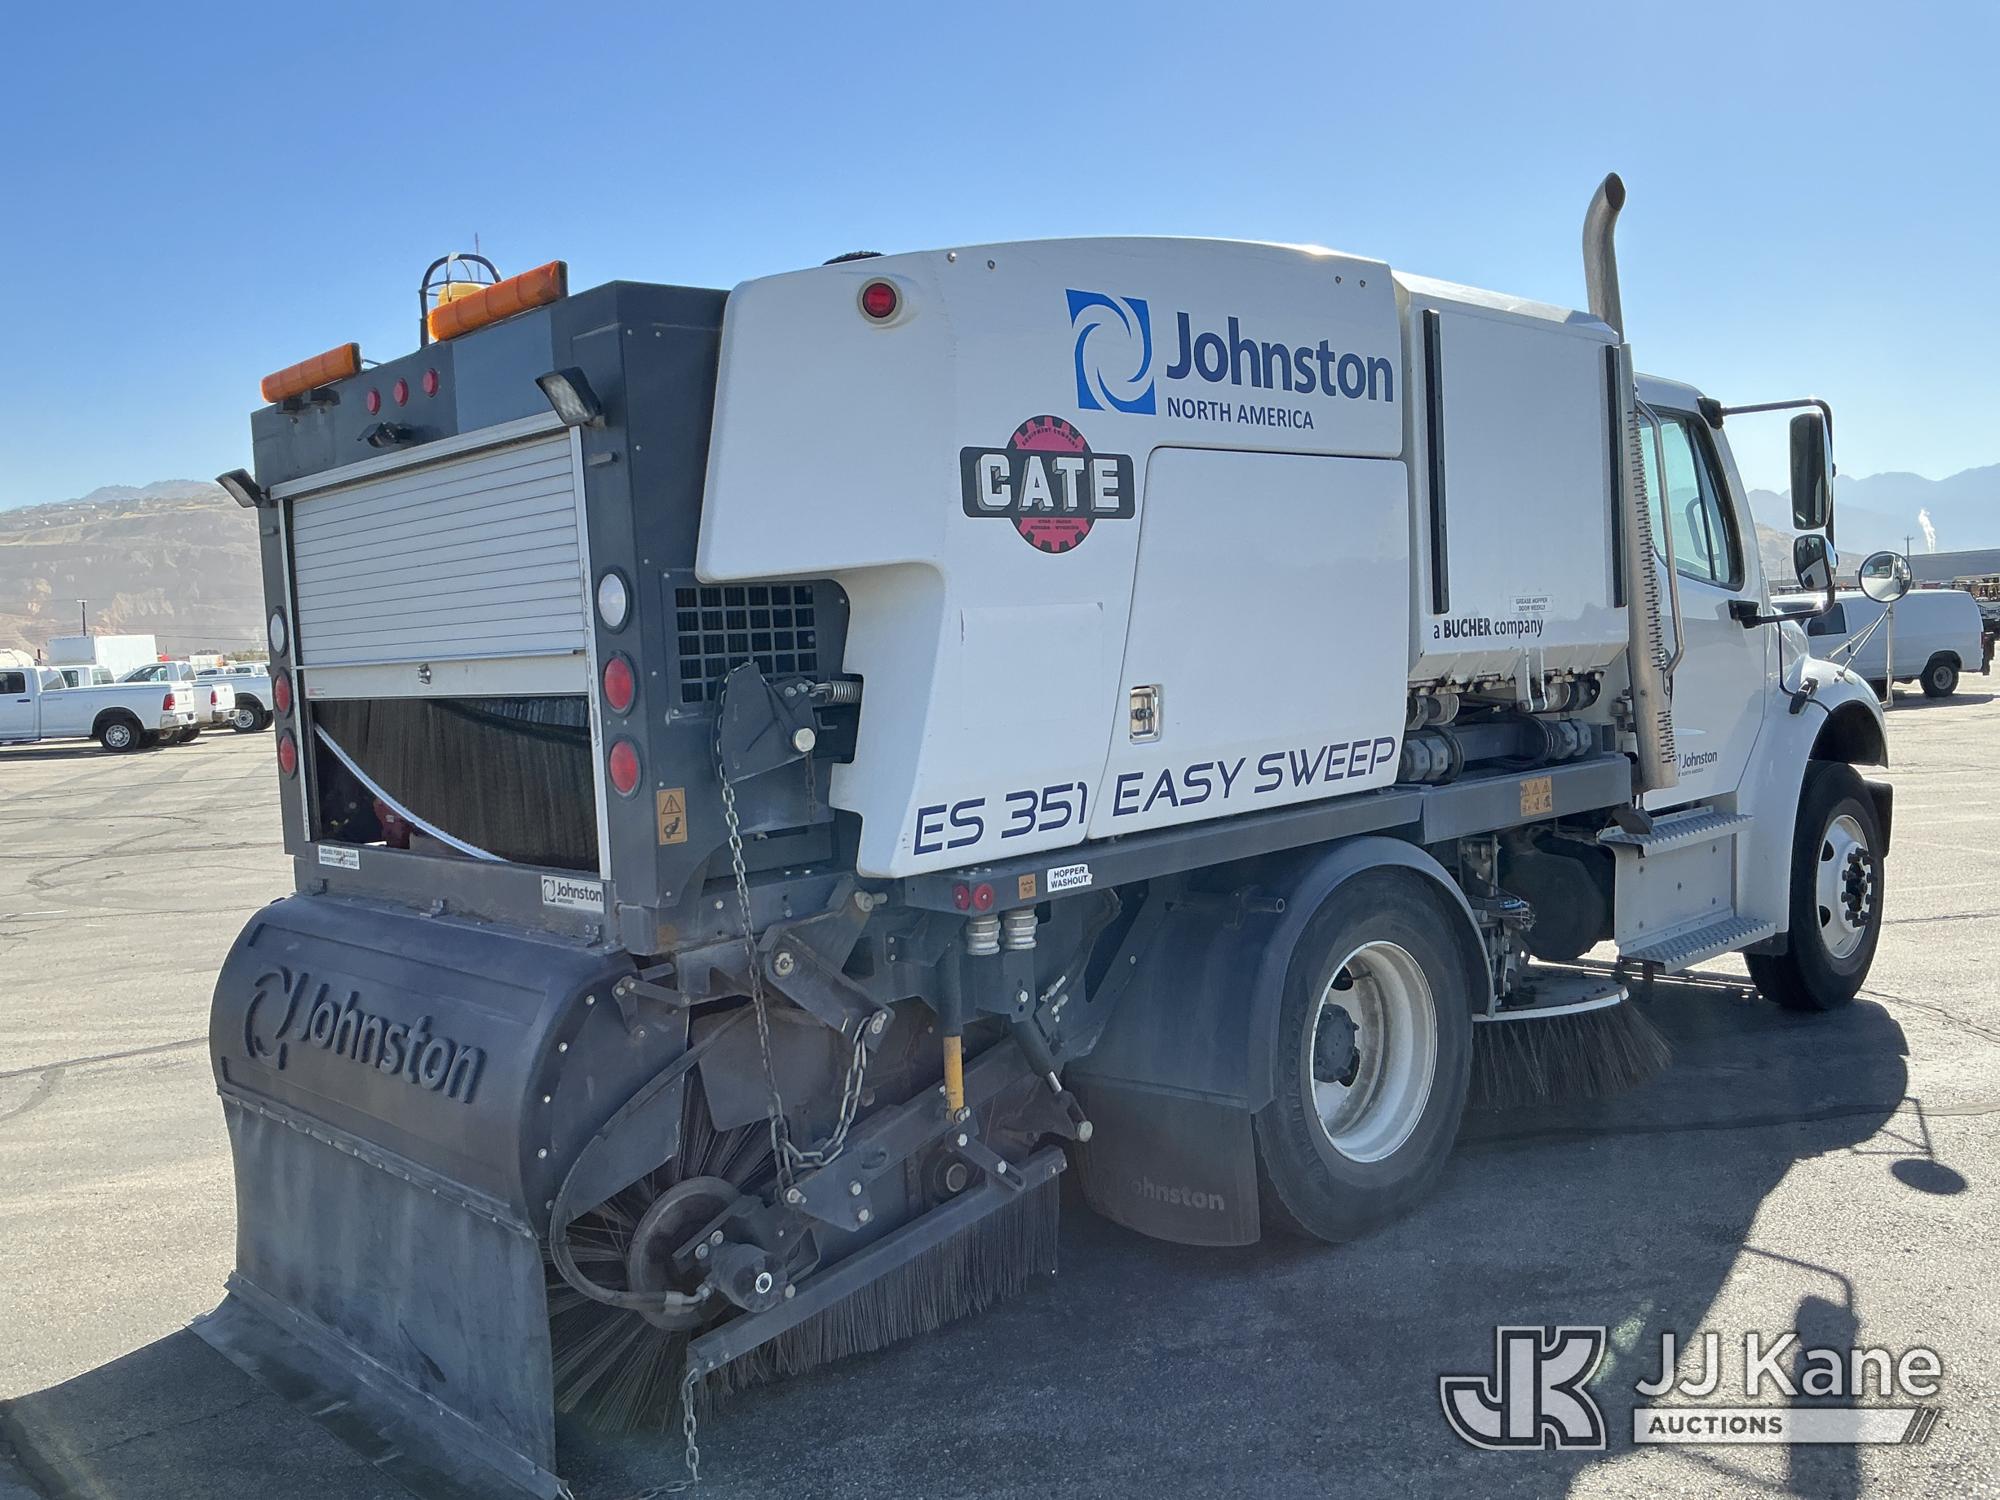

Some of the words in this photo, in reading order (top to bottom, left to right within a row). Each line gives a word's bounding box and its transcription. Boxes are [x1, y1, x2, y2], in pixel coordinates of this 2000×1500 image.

[1167, 312, 1394, 402] Johnston
[1167, 397, 1231, 423] NORTH
[1237, 404, 1314, 430] AMERICA
[975, 453, 1120, 513] CATE
[1433, 623, 1440, 639] a
[1443, 617, 1492, 639] BUCHER
[1494, 619, 1544, 639] company
[1682, 751, 1718, 769] Johnston
[913, 797, 986, 855] ES
[1001, 781, 1089, 839] 351
[1112, 758, 1247, 816] EASY
[1254, 736, 1396, 794] SWEEP
[1050, 874, 1089, 889] WASHOUT
[1053, 866, 1085, 879] HOPPER
[557, 881, 602, 902] Johnston
[295, 982, 488, 1104] Johnston
[1130, 1175, 1225, 1211] ohnston
